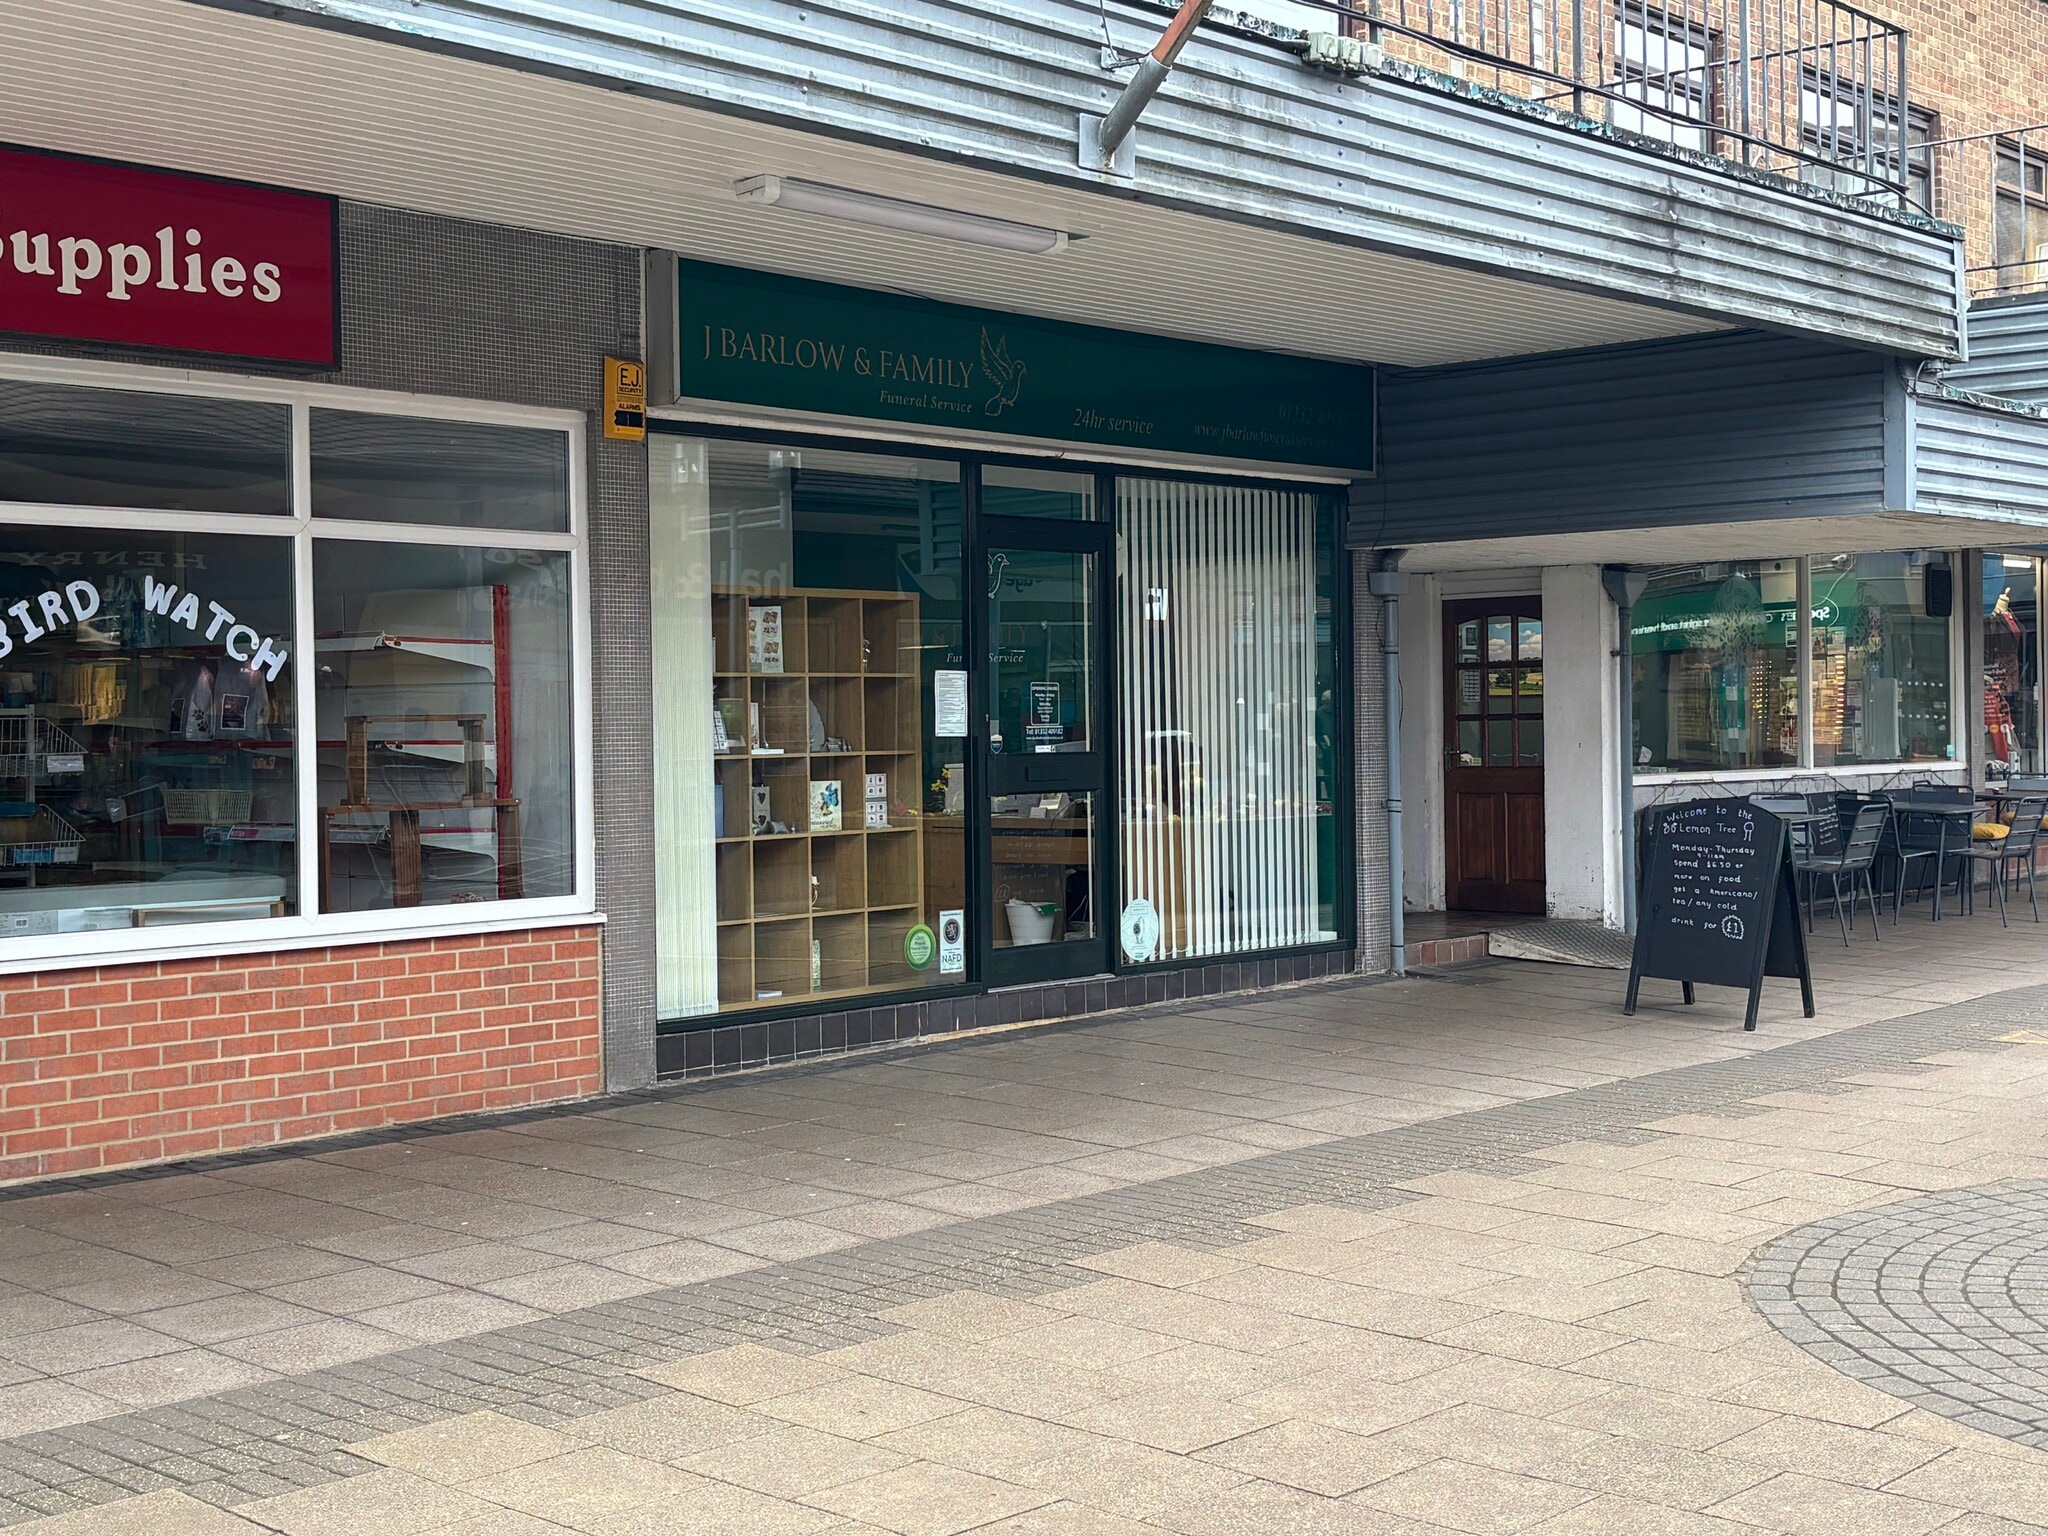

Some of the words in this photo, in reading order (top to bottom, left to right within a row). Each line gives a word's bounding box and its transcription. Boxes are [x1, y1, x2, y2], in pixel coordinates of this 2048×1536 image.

[0, 226, 281, 302] upplies
[703, 325, 711, 360] J
[719, 327, 846, 372] BARLOW
[854, 347, 872, 376] &
[880, 350, 974, 389] FAMILY
[880, 390, 927, 408] Funeral
[930, 396, 972, 413] Service
[1073, 408, 1105, 428] 24hr
[1107, 415, 1154, 434] service
[144, 575, 288, 682] WATCH
[1666, 808, 1707, 822] Welcome
[1716, 804, 1727, 814] to
[1738, 808, 1753, 820] the
[1679, 823, 1711, 834] Lemon
[1716, 823, 1736, 833] Tree
[1718, 875, 1742, 883] food
[1717, 902, 1738, 911] cold
[1671, 917, 1694, 926] drink
[1726, 921, 1739, 933] £1
[942, 953, 962, 963] NAFD
